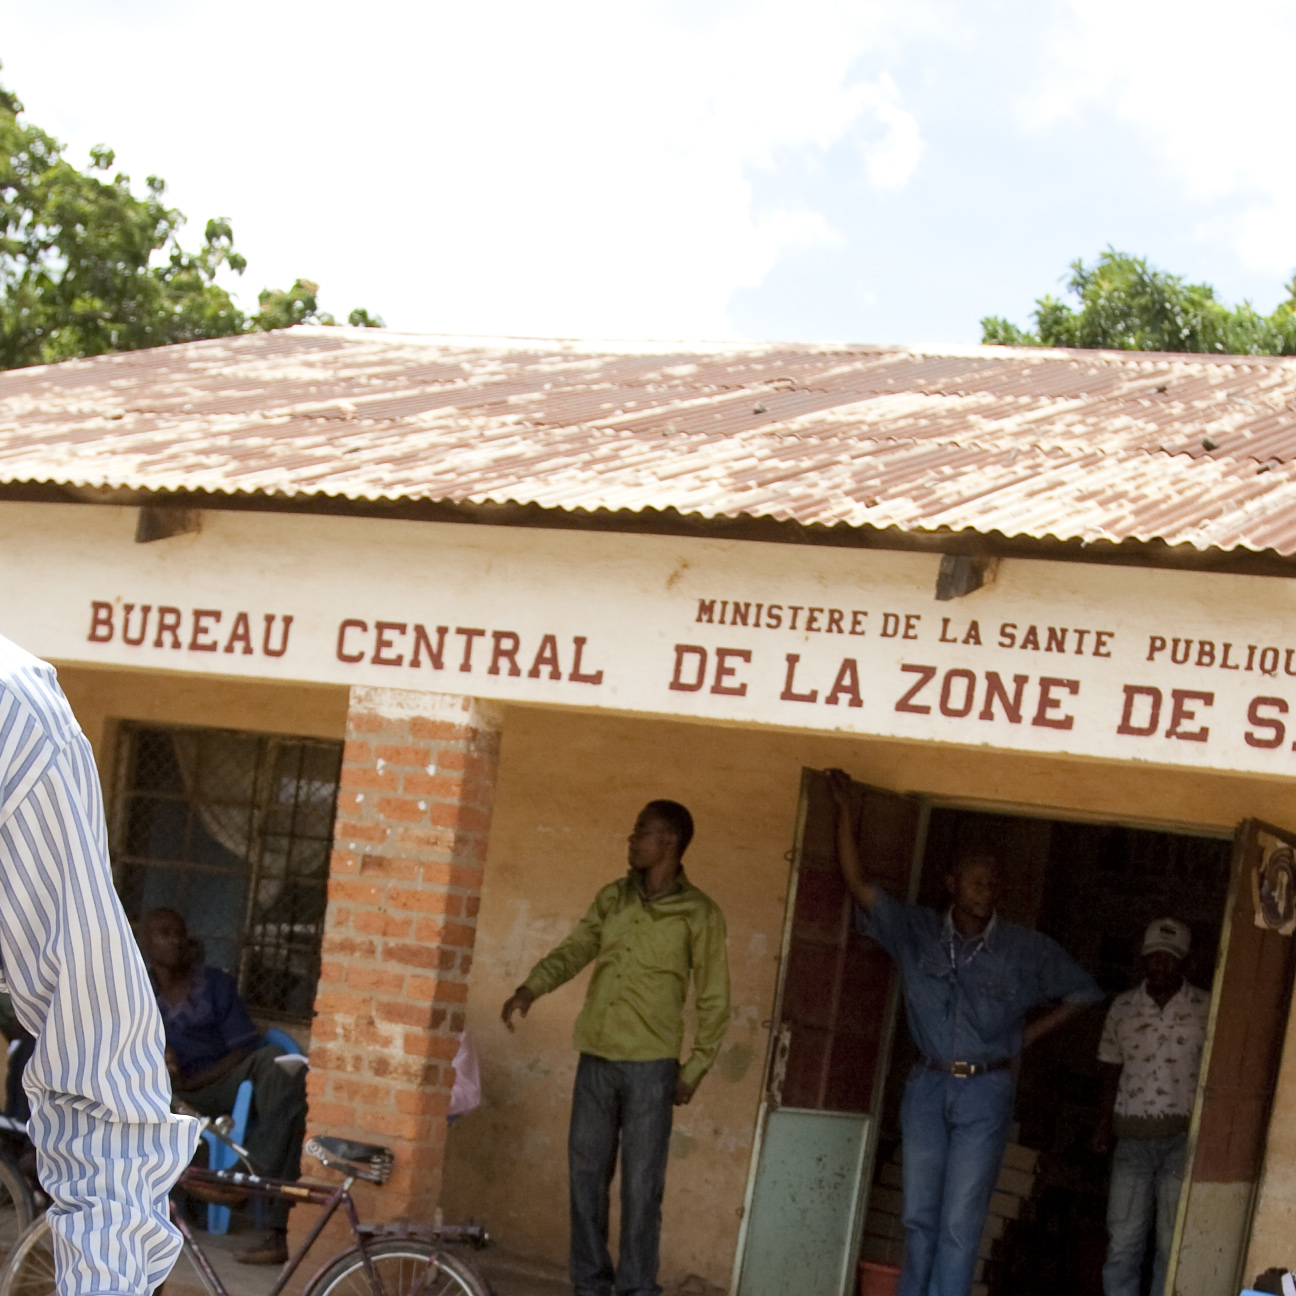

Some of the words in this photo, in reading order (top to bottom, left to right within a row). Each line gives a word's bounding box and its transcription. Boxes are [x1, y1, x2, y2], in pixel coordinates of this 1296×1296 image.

[88, 601, 295, 658] BUREAU
[335, 618, 603, 685] CENTRAL
[669, 644, 753, 698] DE
[780, 653, 864, 708] LA
[894, 663, 1080, 730] ZONE
[1116, 684, 1215, 743] DE
[695, 599, 868, 636] MINISTERE
[880, 612, 921, 640] DE
[939, 617, 982, 646] LA
[998, 622, 1115, 658] SANTE
